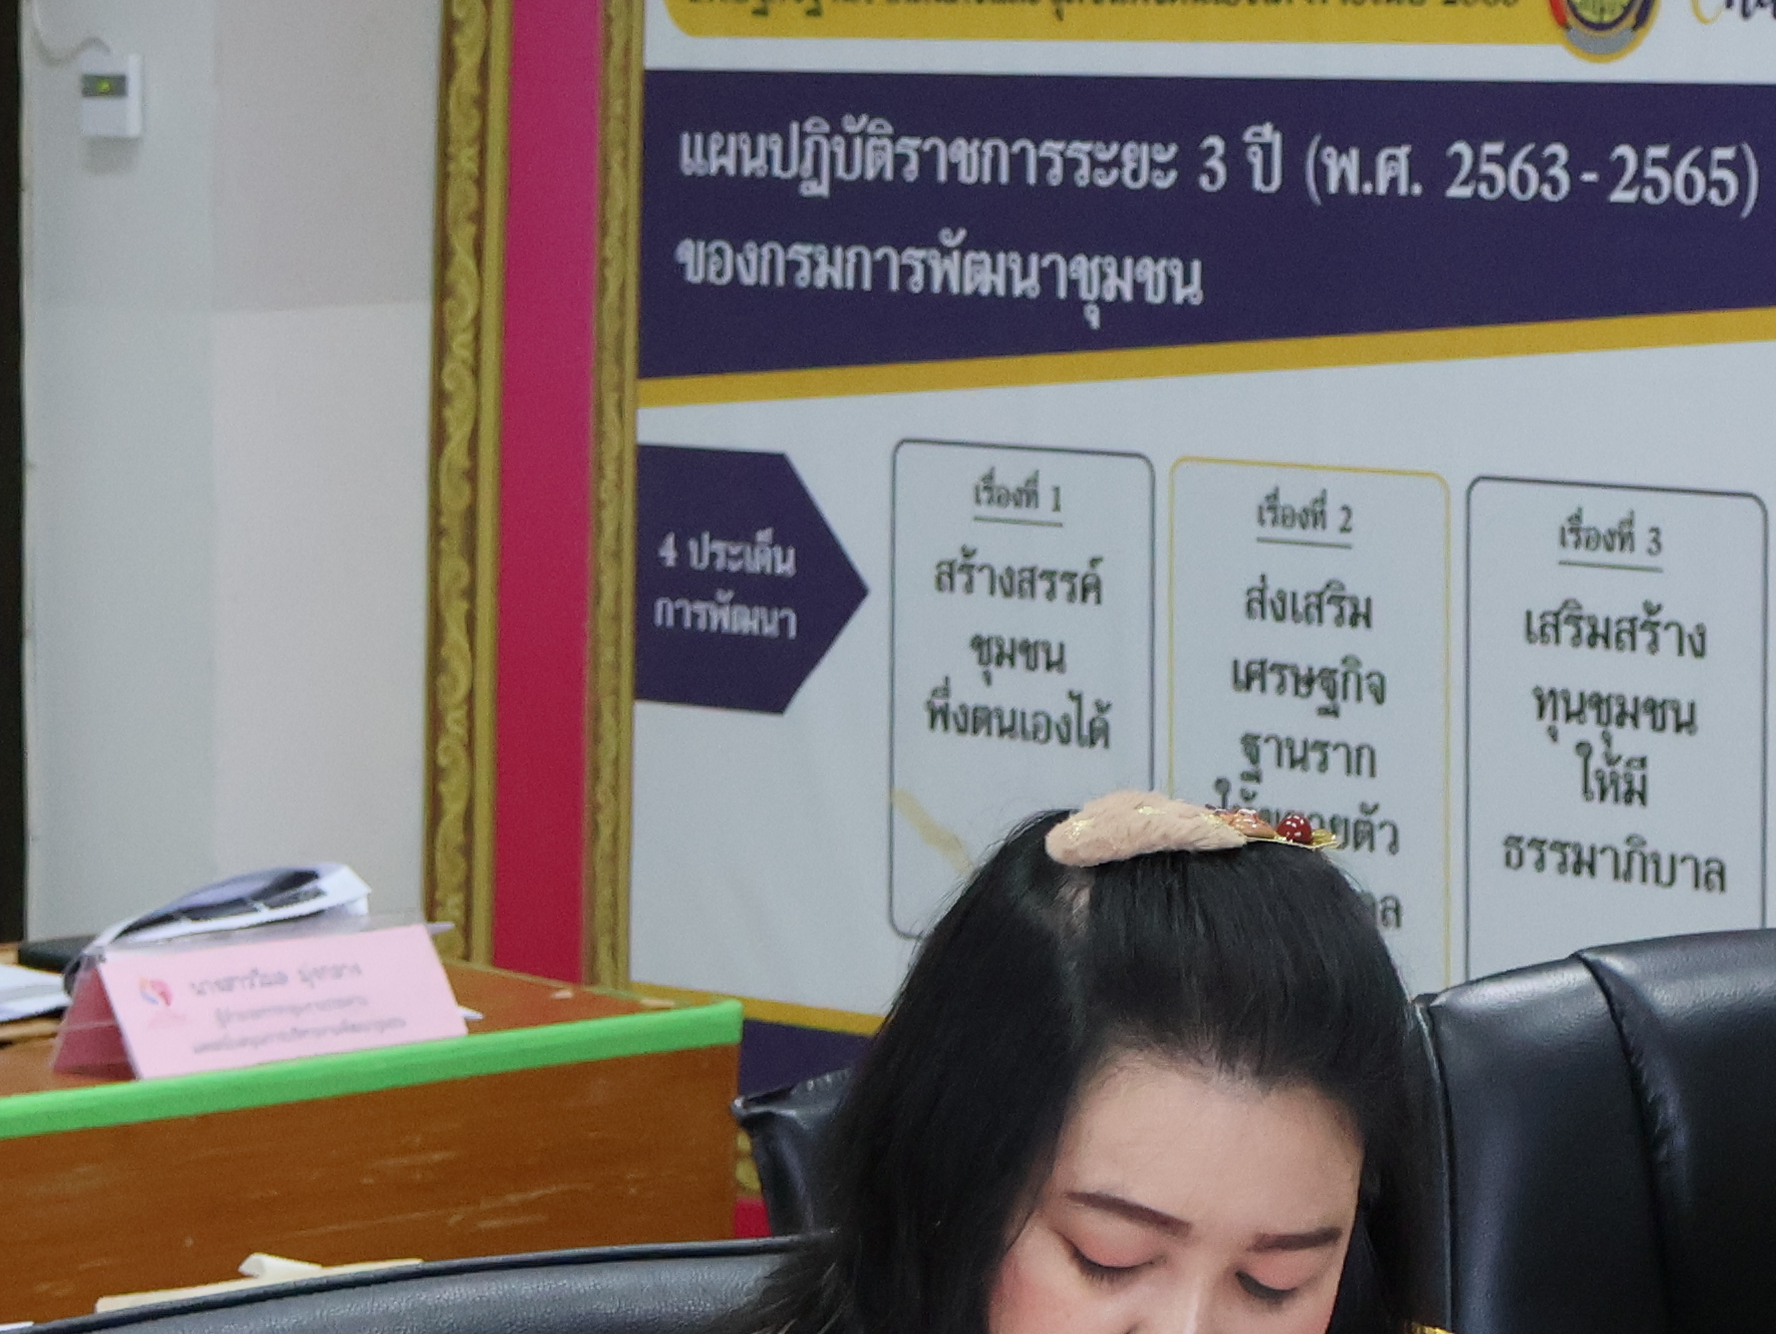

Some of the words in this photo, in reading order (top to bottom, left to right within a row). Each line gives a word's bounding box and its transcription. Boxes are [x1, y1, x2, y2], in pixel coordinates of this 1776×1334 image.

[680, 113, 1178, 198] แผนปฏิบัติราชการระยะ
[1199, 136, 1226, 192] 3
[1242, 121, 1283, 194] ปี
[1305, 134, 1423, 206] (พ.ศ.
[676, 227, 1205, 330] ของกรมการพัฒนาชุมชน
[973, 468, 1042, 512] เรื่องที่
[1051, 485, 1064, 514] 1
[1256, 487, 1330, 534] เรื่องที่
[1338, 504, 1354, 534] 2
[658, 532, 680, 568] 4
[688, 527, 797, 578] ประเด็น
[1558, 507, 1637, 557] เรื่องที่
[1647, 526, 1663, 558] 3
[933, 545, 1105, 607] สร้างสรรค์
[1244, 577, 1373, 630] ส่งเสริม
[654, 590, 797, 640] การพัฒนา
[1524, 600, 1708, 660] เสริมสร้าง
[970, 632, 1067, 684] ชุมชน
[1230, 655, 1387, 717] เศรษฐกิจ
[925, 678, 1112, 751] พึ่งตนเองได้
[1532, 682, 1698, 749] ทุนชุมชน
[1240, 728, 1378, 785] ฐานราก
[1575, 744, 1649, 809] ให้มี
[1503, 832, 1727, 895] ธรรมาภิบาล
